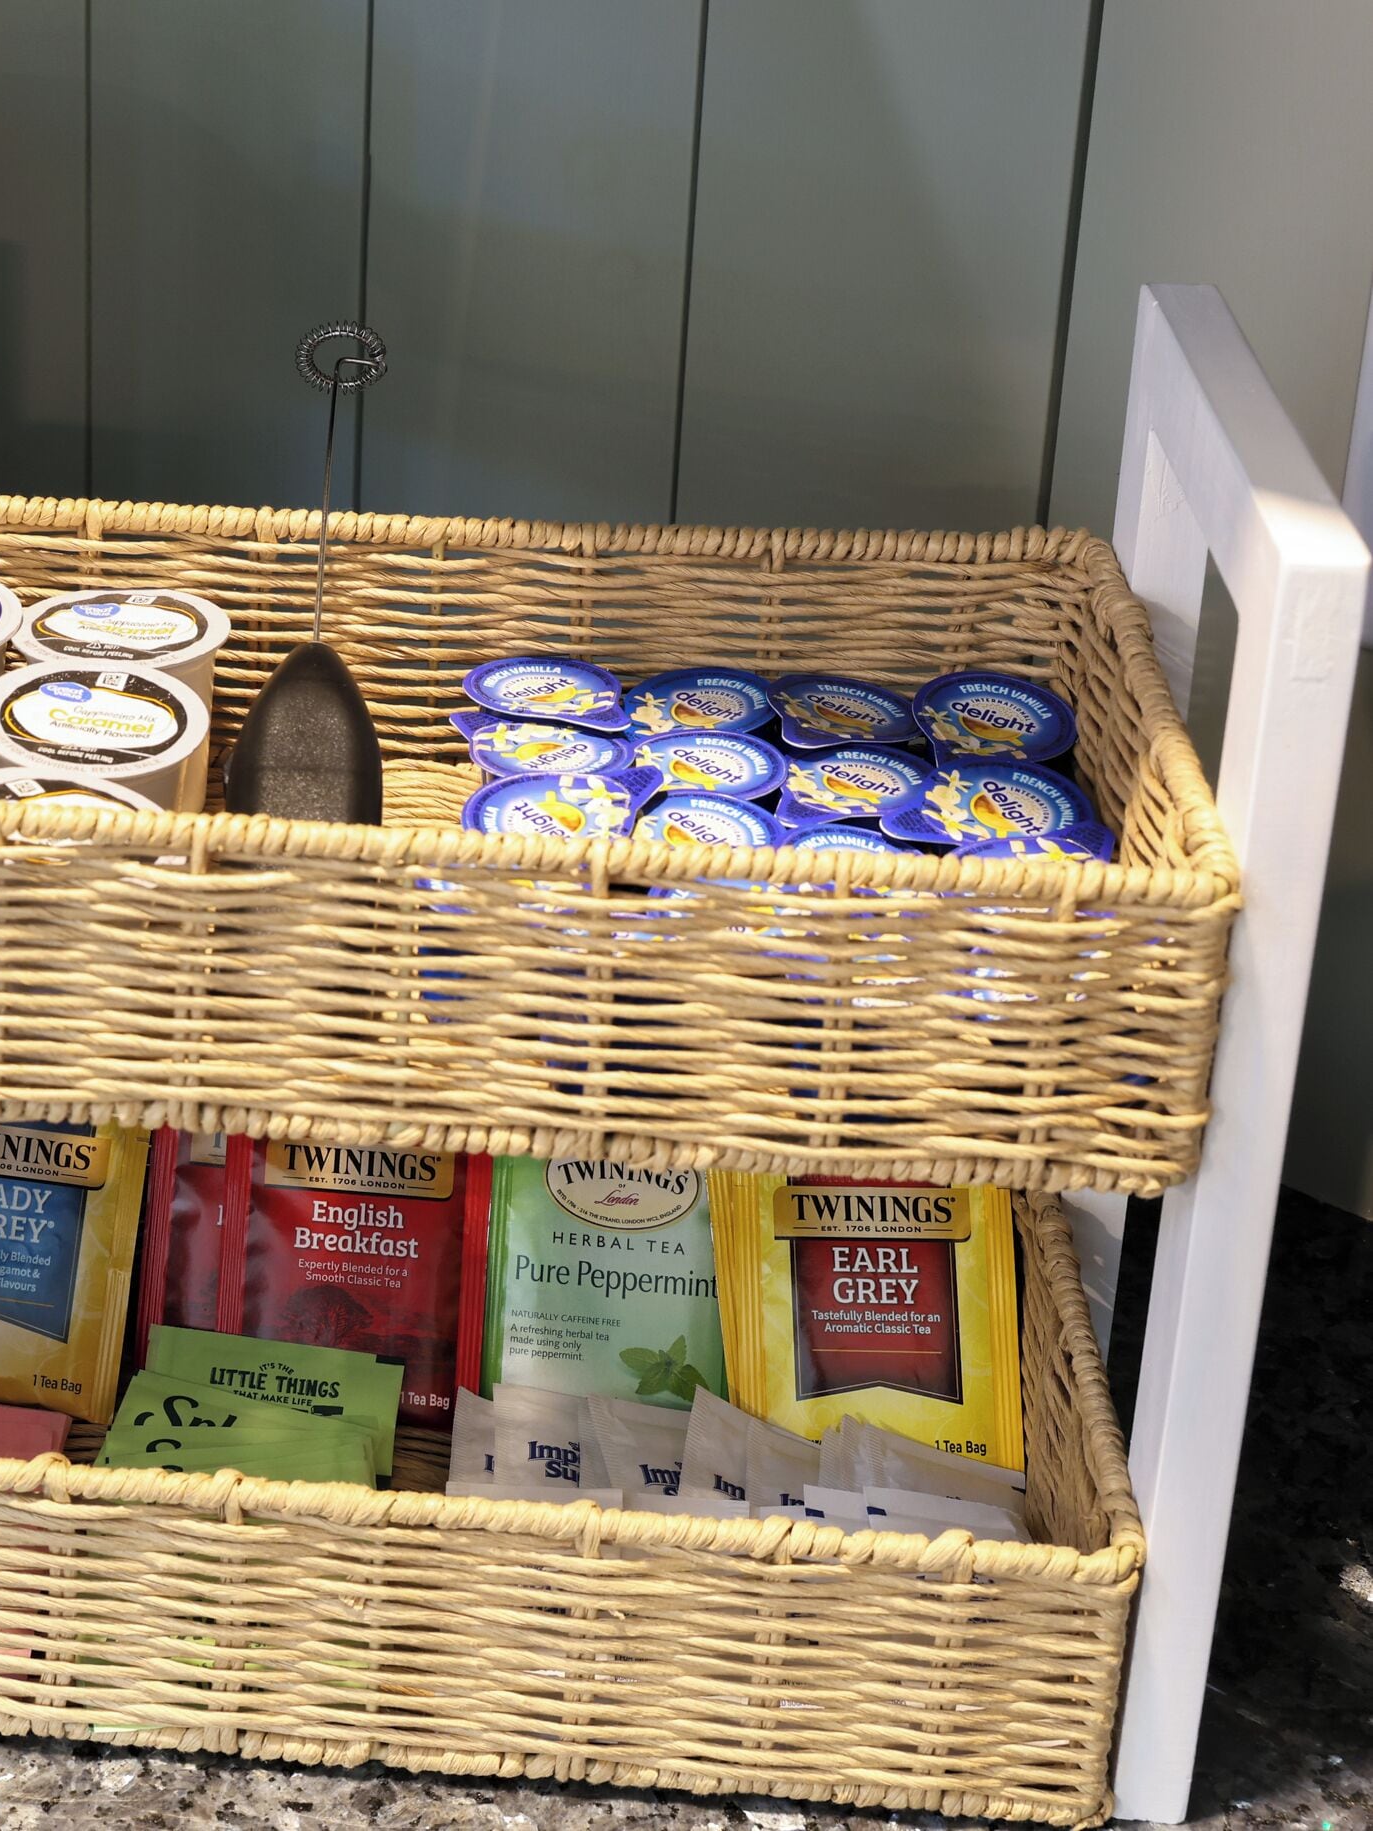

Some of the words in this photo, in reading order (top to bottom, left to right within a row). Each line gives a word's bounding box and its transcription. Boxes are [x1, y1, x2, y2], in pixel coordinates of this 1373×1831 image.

[503, 677, 575, 699] delight
[697, 678, 744, 690] FRENCH
[817, 684, 866, 697] FRENCH
[676, 692, 743, 720] delight
[807, 694, 887, 725] delight
[959, 683, 1009, 695] FRENCH
[1011, 689, 1052, 720] VANILLA
[49, 708, 154, 734] Caramel
[951, 701, 1036, 734] delight
[696, 738, 743, 752] FRENCH
[57, 749, 84, 758] BEFORE
[84, 753, 114, 763] PEELING
[526, 743, 588, 769] delight
[836, 751, 886, 763] FRENCH
[673, 749, 744, 784] delight
[821, 764, 902, 796] delight
[1012, 772, 1061, 798] FRENCH
[690, 799, 739, 818] FRENCH
[983, 780, 1042, 834] delight
[828, 835, 885, 850] VANILLA
[16, 1164, 59, 1177] LONDON
[284, 1143, 438, 1181] TWININGS
[309, 1176, 328, 1184] EST.
[333, 1178, 357, 1186] 1706
[360, 1179, 405, 1190] LONDON
[594, 1189, 640, 1206] London
[312, 1200, 404, 1231] English
[621, 1217, 646, 1225] LONDON
[659, 1204, 683, 1222] ENGLAND
[791, 1194, 952, 1224] TWININGS
[846, 1225, 871, 1233] 1706
[294, 1226, 419, 1259] Breakfast
[553, 1231, 635, 1251] HERBAL
[646, 1240, 686, 1256] TEA
[10, 1251, 51, 1266] Blended
[298, 1258, 340, 1274] Expertly
[342, 1261, 384, 1276] Blended
[385, 1264, 400, 1277] for
[401, 1268, 408, 1277] a
[832, 1246, 919, 1274] EARL
[32, 1269, 41, 1279] &
[305, 1271, 345, 1284] Smooth
[347, 1274, 381, 1288] Classic
[384, 1277, 401, 1289] Tea
[515, 1254, 571, 1285] Pure
[577, 1260, 719, 1299] Peppermint
[832, 1277, 919, 1305] GREY
[511, 1309, 559, 1321] NATURALLY
[560, 1314, 601, 1326] CAFFEINE
[601, 1319, 621, 1328] FREE
[811, 1310, 863, 1323] Tastefully
[864, 1311, 909, 1322] Blended
[910, 1311, 926, 1322] for
[927, 1314, 941, 1323] an
[510, 1323, 518, 1332] A
[520, 1324, 563, 1339] refreshing
[565, 1328, 594, 1341] herbal
[595, 1333, 610, 1341] tea
[824, 1322, 873, 1333] Aromatic
[874, 1323, 911, 1334] Classic
[912, 1324, 931, 1334] Tea
[510, 1335, 534, 1345] made
[536, 1338, 560, 1350] using
[562, 1340, 582, 1352] only
[509, 1347, 529, 1358] pure
[531, 1347, 585, 1362] peppermint.
[259, 1362, 275, 1373] IT'S
[277, 1362, 294, 1375] THE
[33, 1374, 38, 1387] 1
[40, 1375, 58, 1390] Tea
[60, 1378, 82, 1395] Bag
[210, 1366, 268, 1390] LITTLE
[275, 1375, 341, 1399] THINGS
[260, 1393, 289, 1404] MAKE
[292, 1397, 313, 1407] LIFE
[408, 1392, 427, 1405] Tea
[430, 1394, 451, 1410] Bag
[935, 1440, 940, 1450] 1
[943, 1440, 962, 1453] Tea
[965, 1441, 987, 1456] Bag
